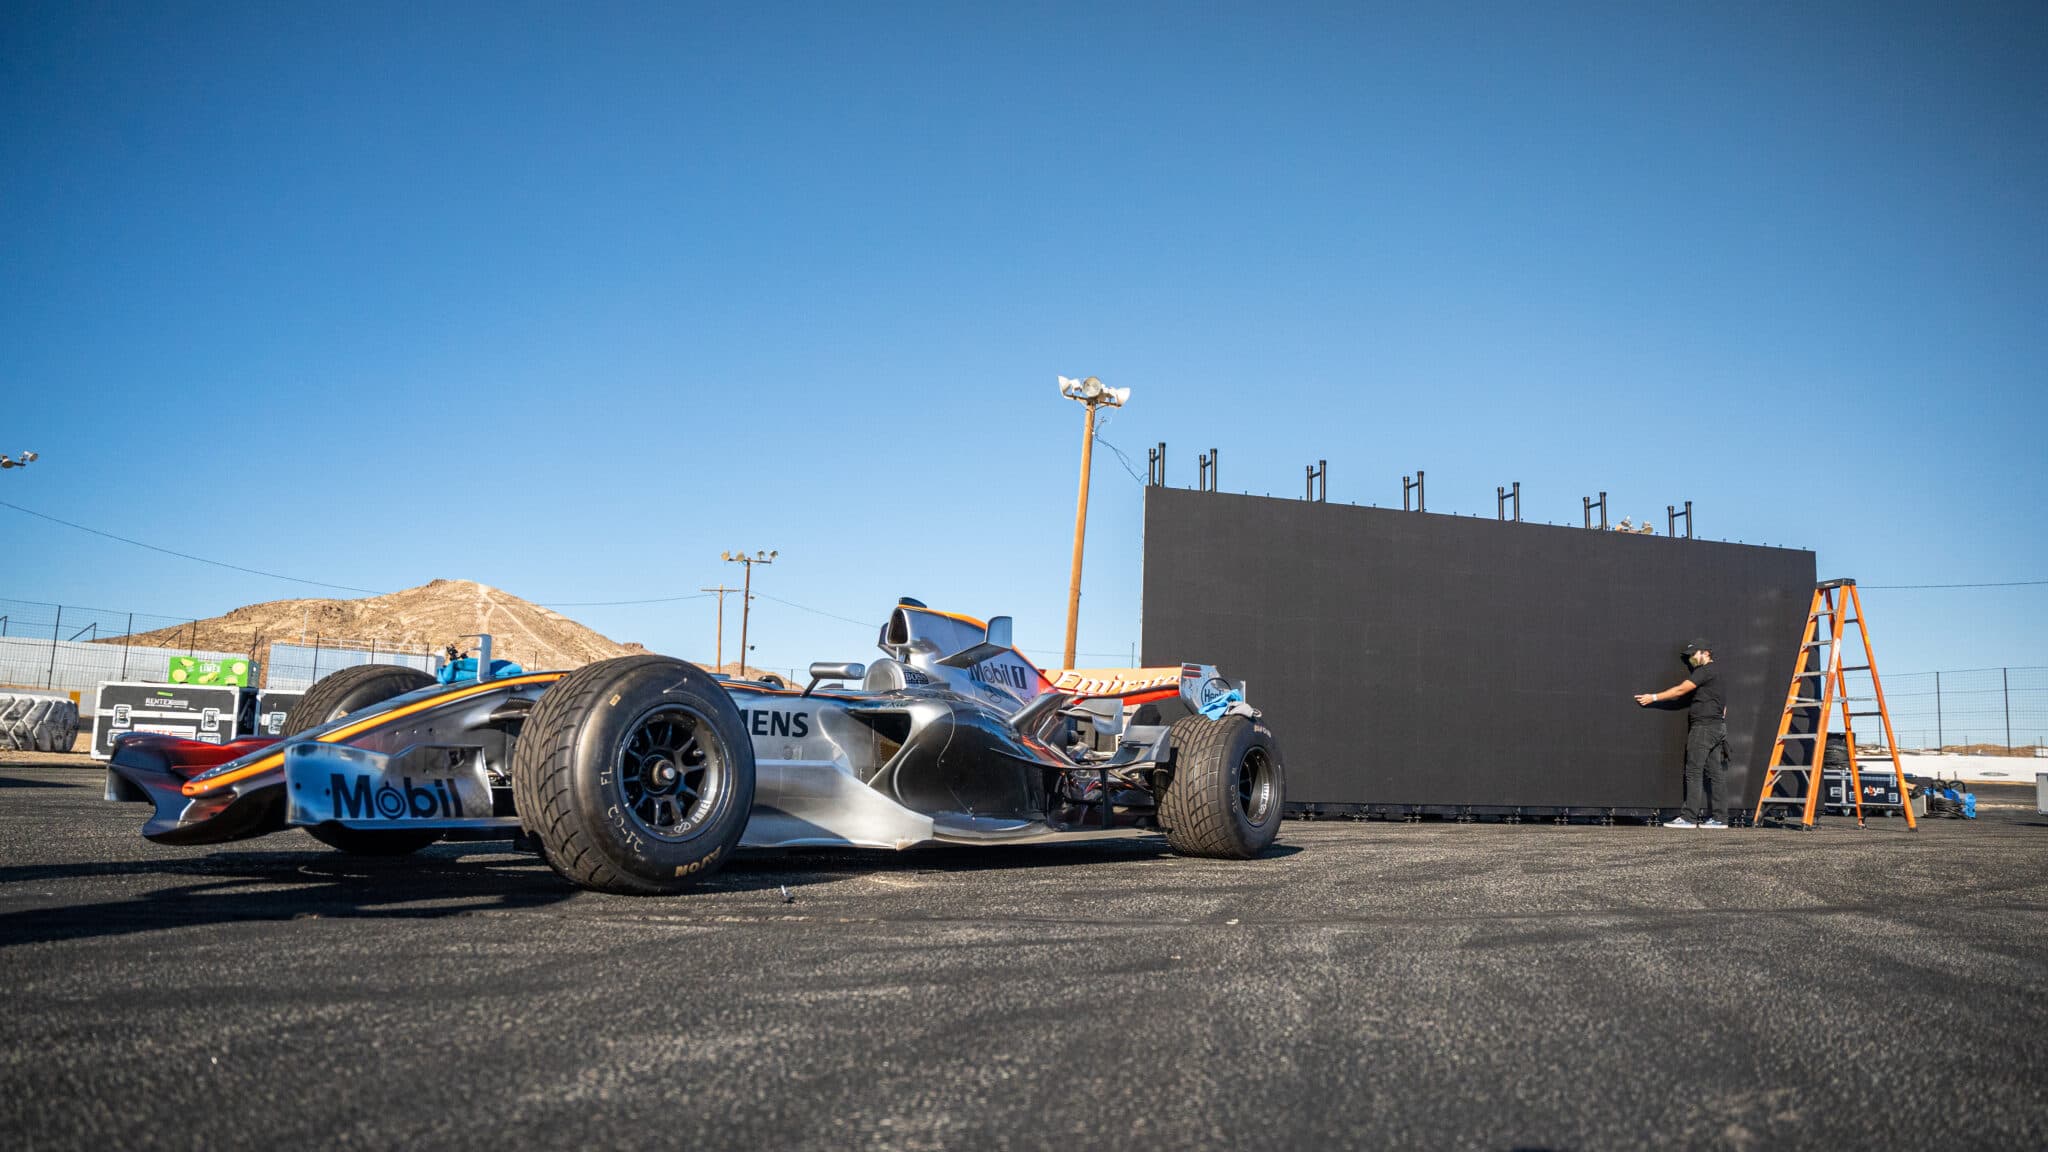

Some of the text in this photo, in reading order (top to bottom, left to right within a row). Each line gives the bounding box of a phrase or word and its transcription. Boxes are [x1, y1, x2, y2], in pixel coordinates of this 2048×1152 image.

[969, 662, 1011, 687] Mobil
[330, 773, 464, 819] Mobil
[674, 846, 721, 877] AVON
